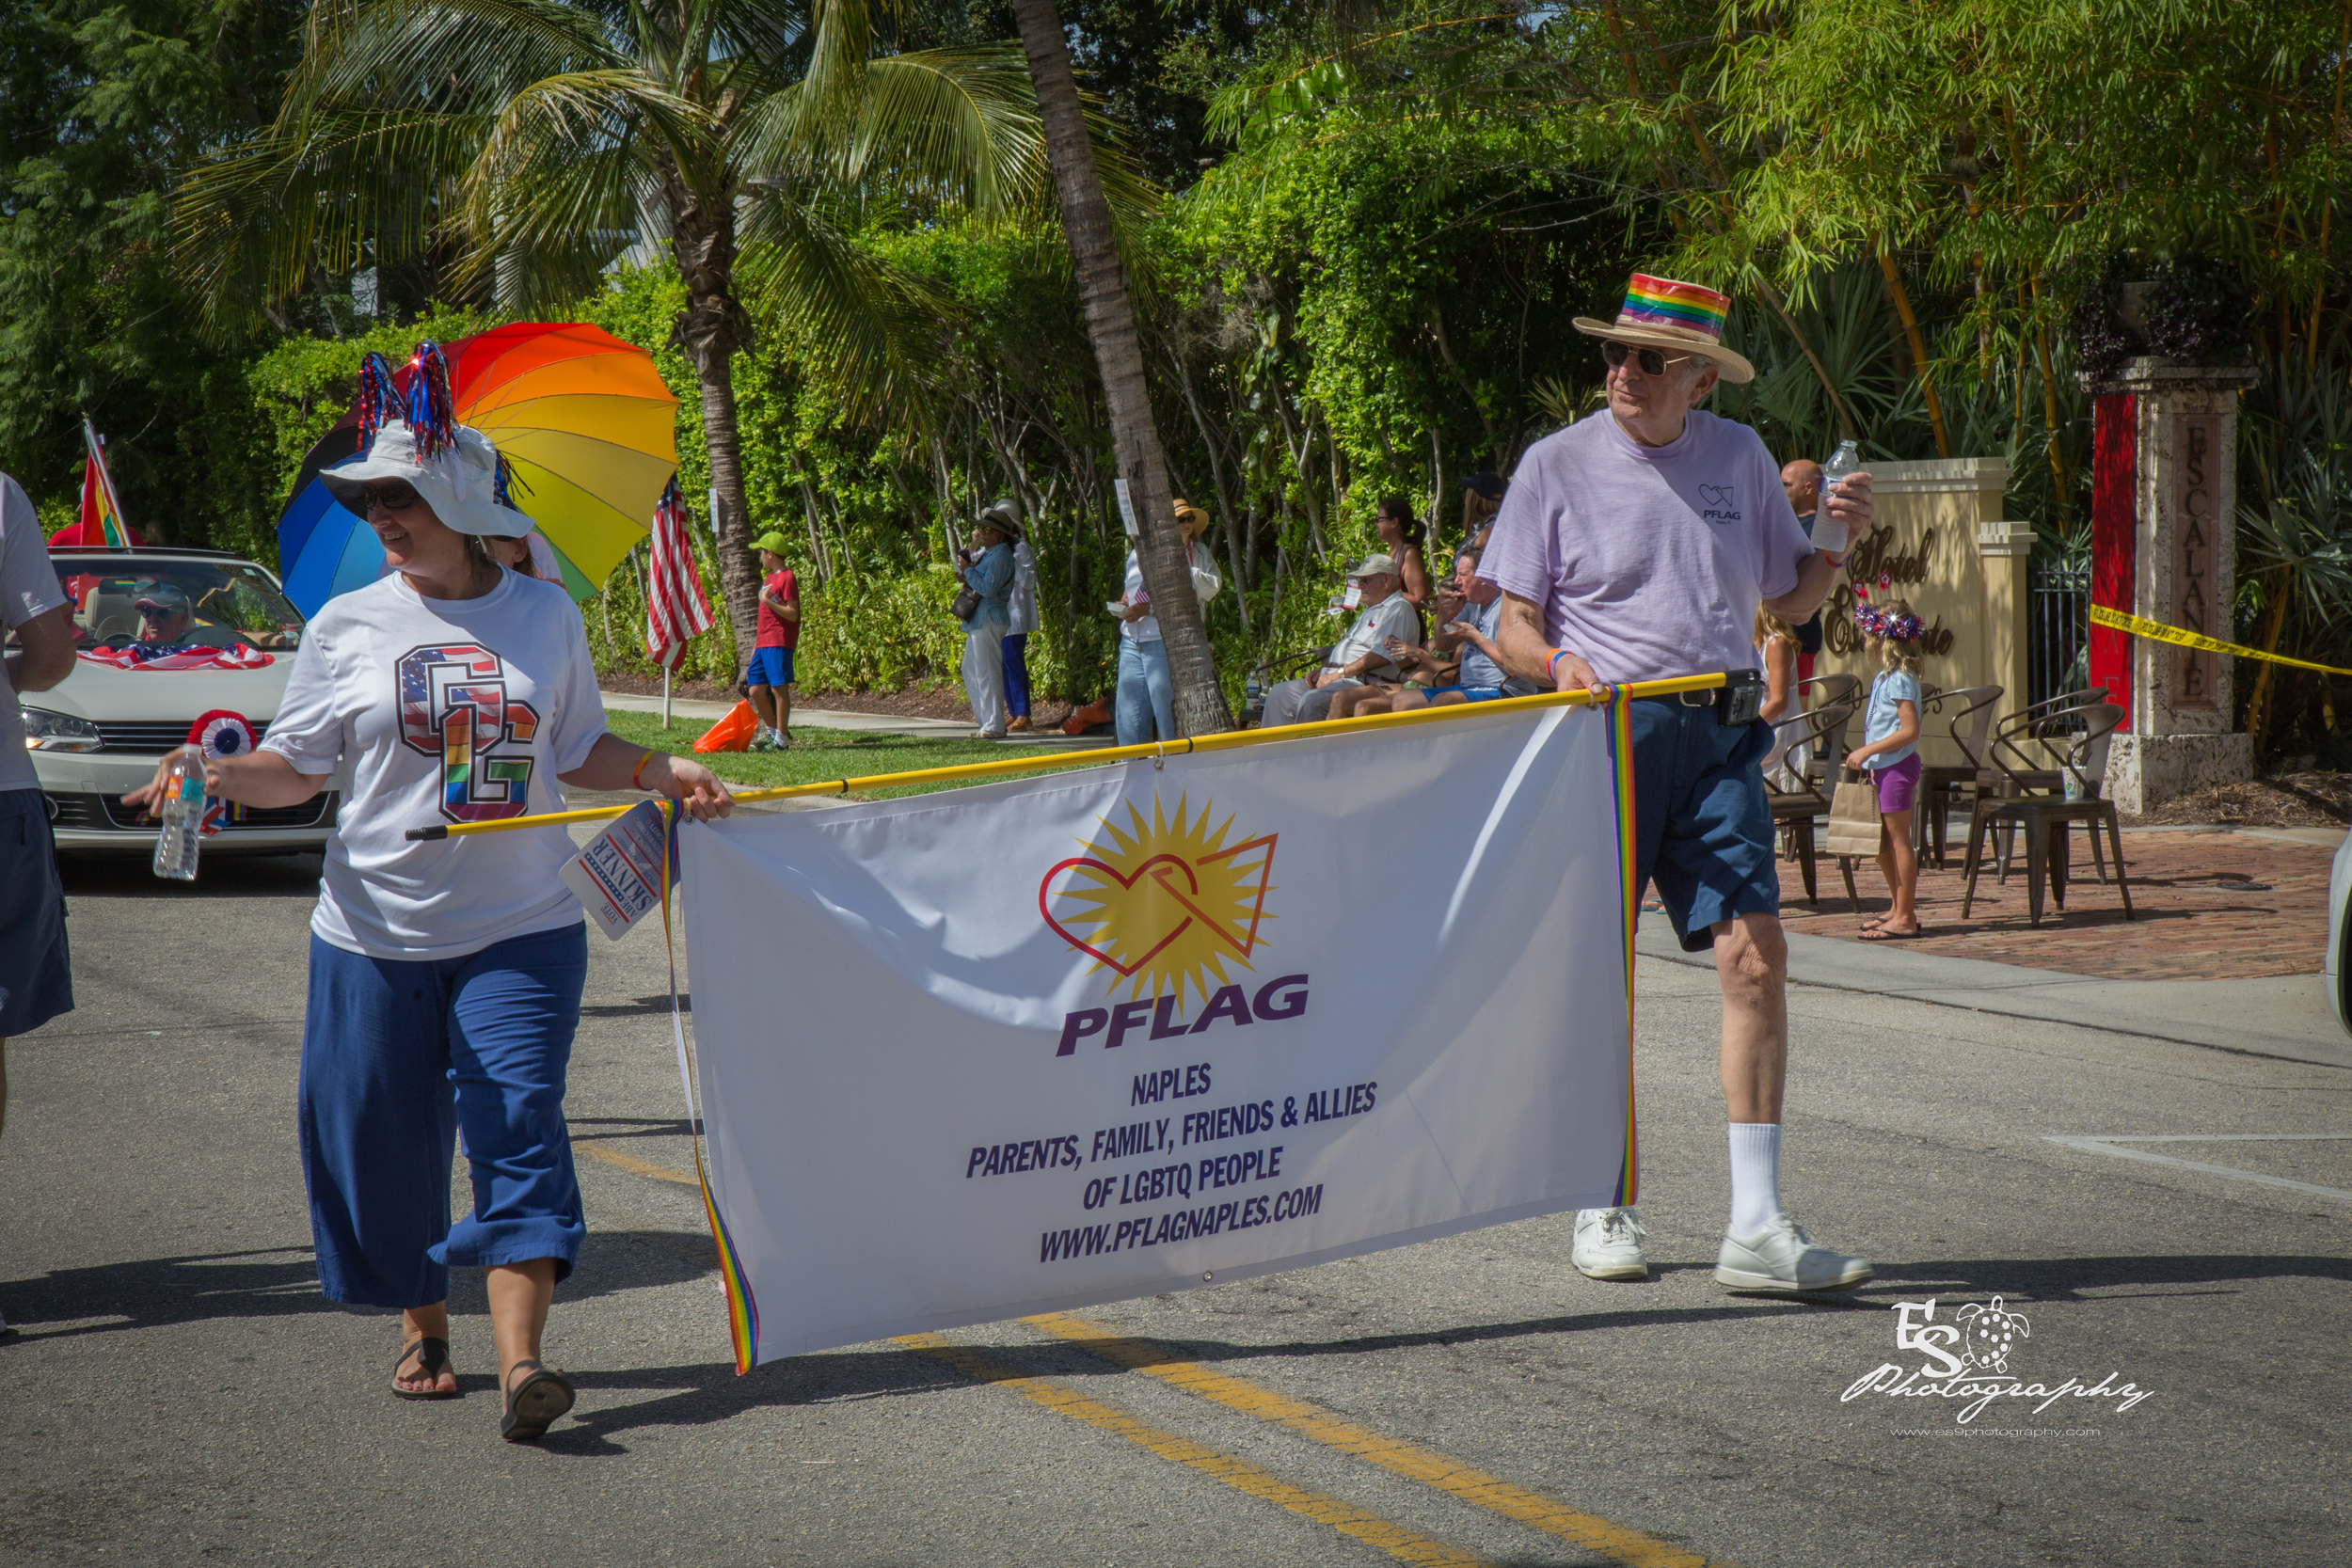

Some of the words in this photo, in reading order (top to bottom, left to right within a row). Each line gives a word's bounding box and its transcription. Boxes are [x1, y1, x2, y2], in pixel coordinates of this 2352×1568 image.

[1703, 510, 1741, 520] PFLAG
[616, 835, 638, 862] APPRAISER
[637, 820, 655, 844] RECORD
[593, 838, 652, 911] SKINNER
[636, 860, 656, 886] PROPERTY
[602, 903, 618, 923] VOTE
[620, 899, 638, 918] ABE
[1056, 974, 1310, 1057] PFLAG
[1131, 1063, 1212, 1106] NAPLES
[966, 1134, 1082, 1179] PARENTS,
[1090, 1117, 1175, 1163] FAMILY,
[1182, 1100, 1274, 1146] FRIENDS
[1279, 1096, 1298, 1125] &
[1304, 1082, 1377, 1124] ALLIES
[1083, 1176, 1117, 1210] OF
[1119, 1164, 1192, 1206] LGBTQ
[1199, 1146, 1283, 1191] PEOPLE
[1040, 1183, 1324, 1263] WWW.PFLAGNAPLES.COM
